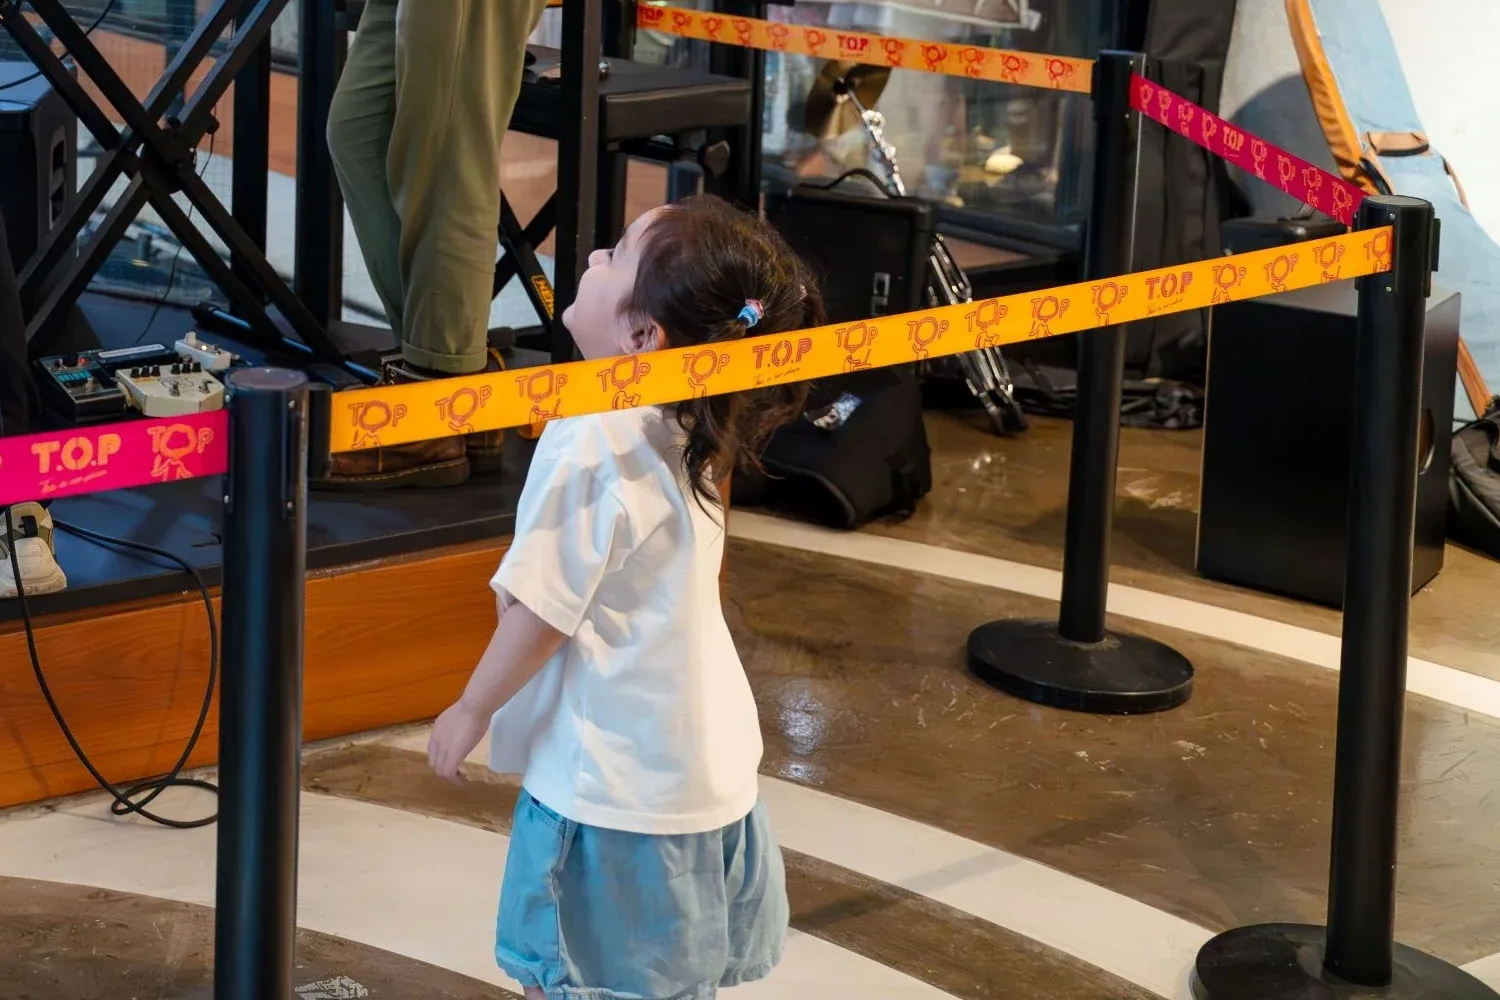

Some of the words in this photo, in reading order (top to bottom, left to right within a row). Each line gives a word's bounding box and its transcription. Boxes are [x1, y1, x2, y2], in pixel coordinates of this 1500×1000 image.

[752, 338, 813, 369] T.O.P
[1145, 271, 1193, 299] T.O.P
[31, 433, 121, 474] T.O.P
